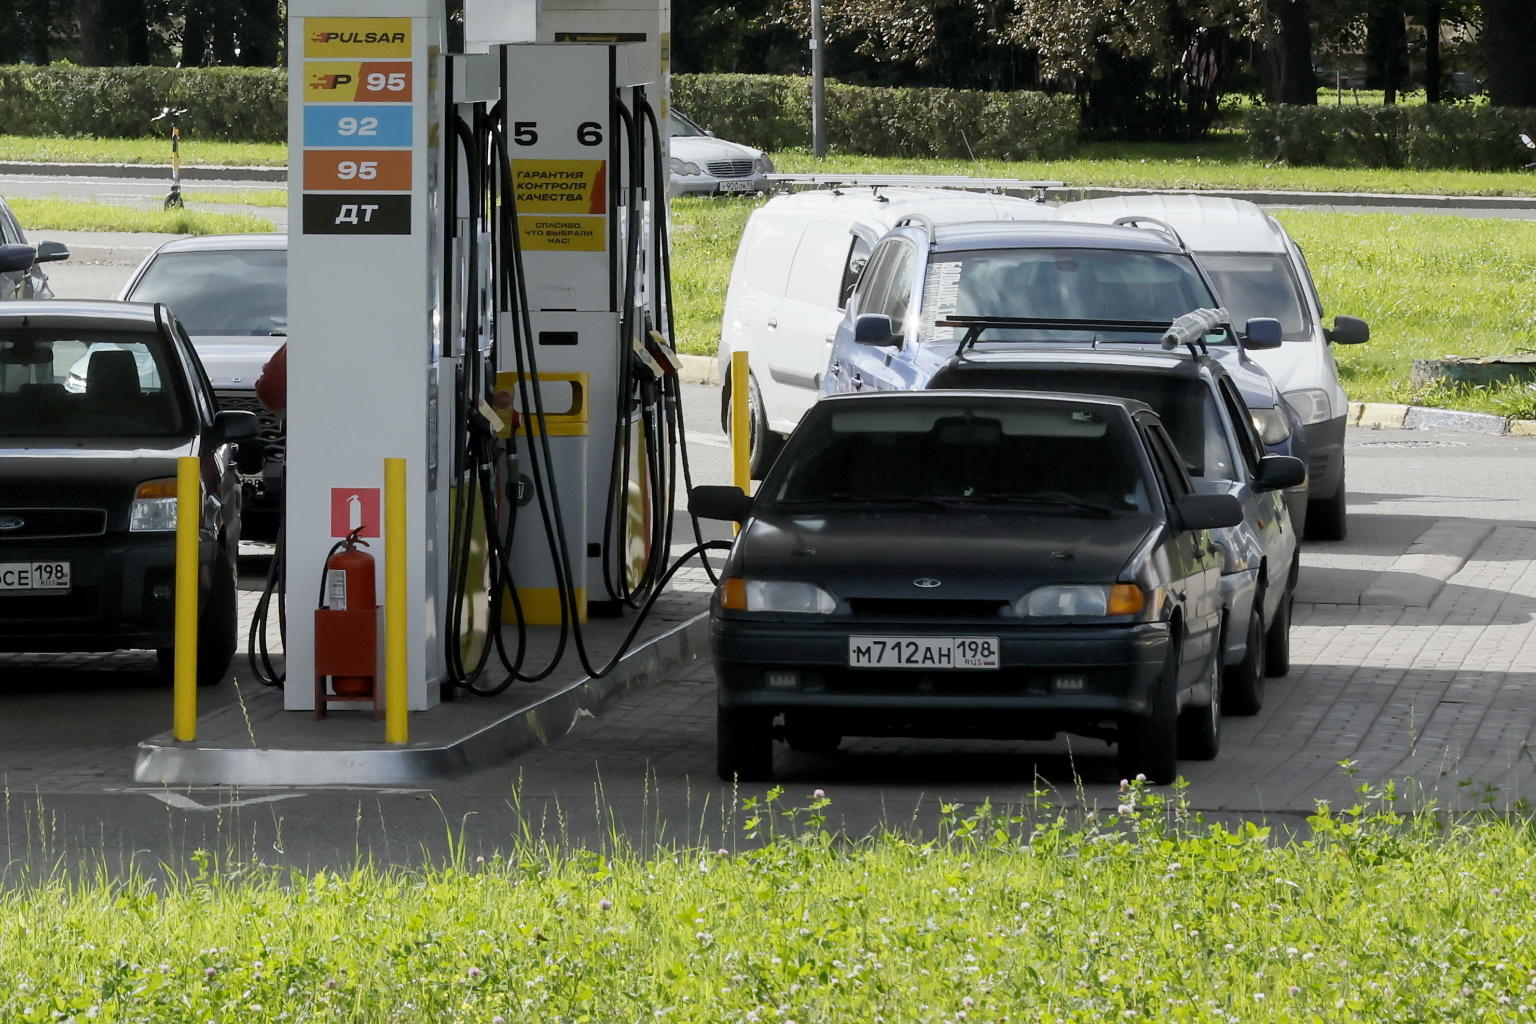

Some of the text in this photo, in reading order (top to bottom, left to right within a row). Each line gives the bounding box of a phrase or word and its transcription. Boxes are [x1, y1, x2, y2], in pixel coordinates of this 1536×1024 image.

[325, 32, 405, 43] PULSAR
[366, 72, 406, 91] 95
[337, 117, 378, 136] 92
[514, 121, 603, 146] 5 6
[337, 161, 378, 180] 95
[517, 171, 584, 179] ГАРАНТИЯ
[517, 182, 587, 191] КОНТРОЛЯ
[517, 193, 584, 202] КАЧЕСТВА
[335, 204, 379, 225] ДТ
[34, 564, 64, 580] 198
[855, 640, 992, 665] М712АН 198
[964, 658, 983, 666] RUS
